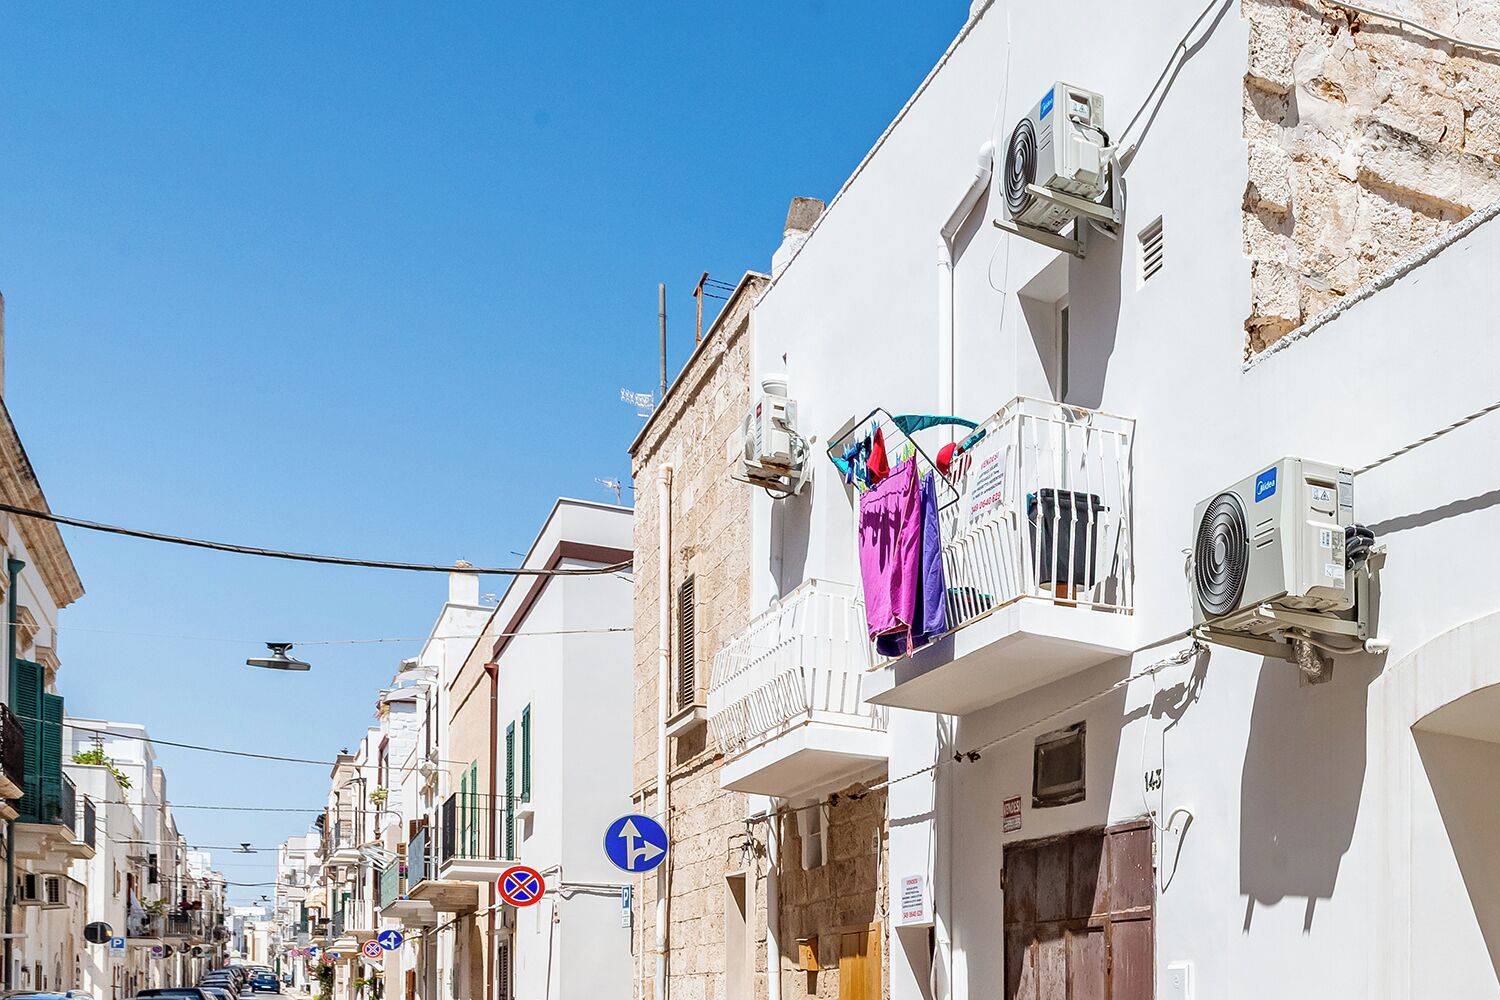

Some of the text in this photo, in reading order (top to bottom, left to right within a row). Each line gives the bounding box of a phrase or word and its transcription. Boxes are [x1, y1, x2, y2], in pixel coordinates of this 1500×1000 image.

[1257, 479, 1275, 495] Midea
[1144, 768, 1162, 792] 143
[623, 888, 629, 907] P
[113, 940, 122, 948] P
